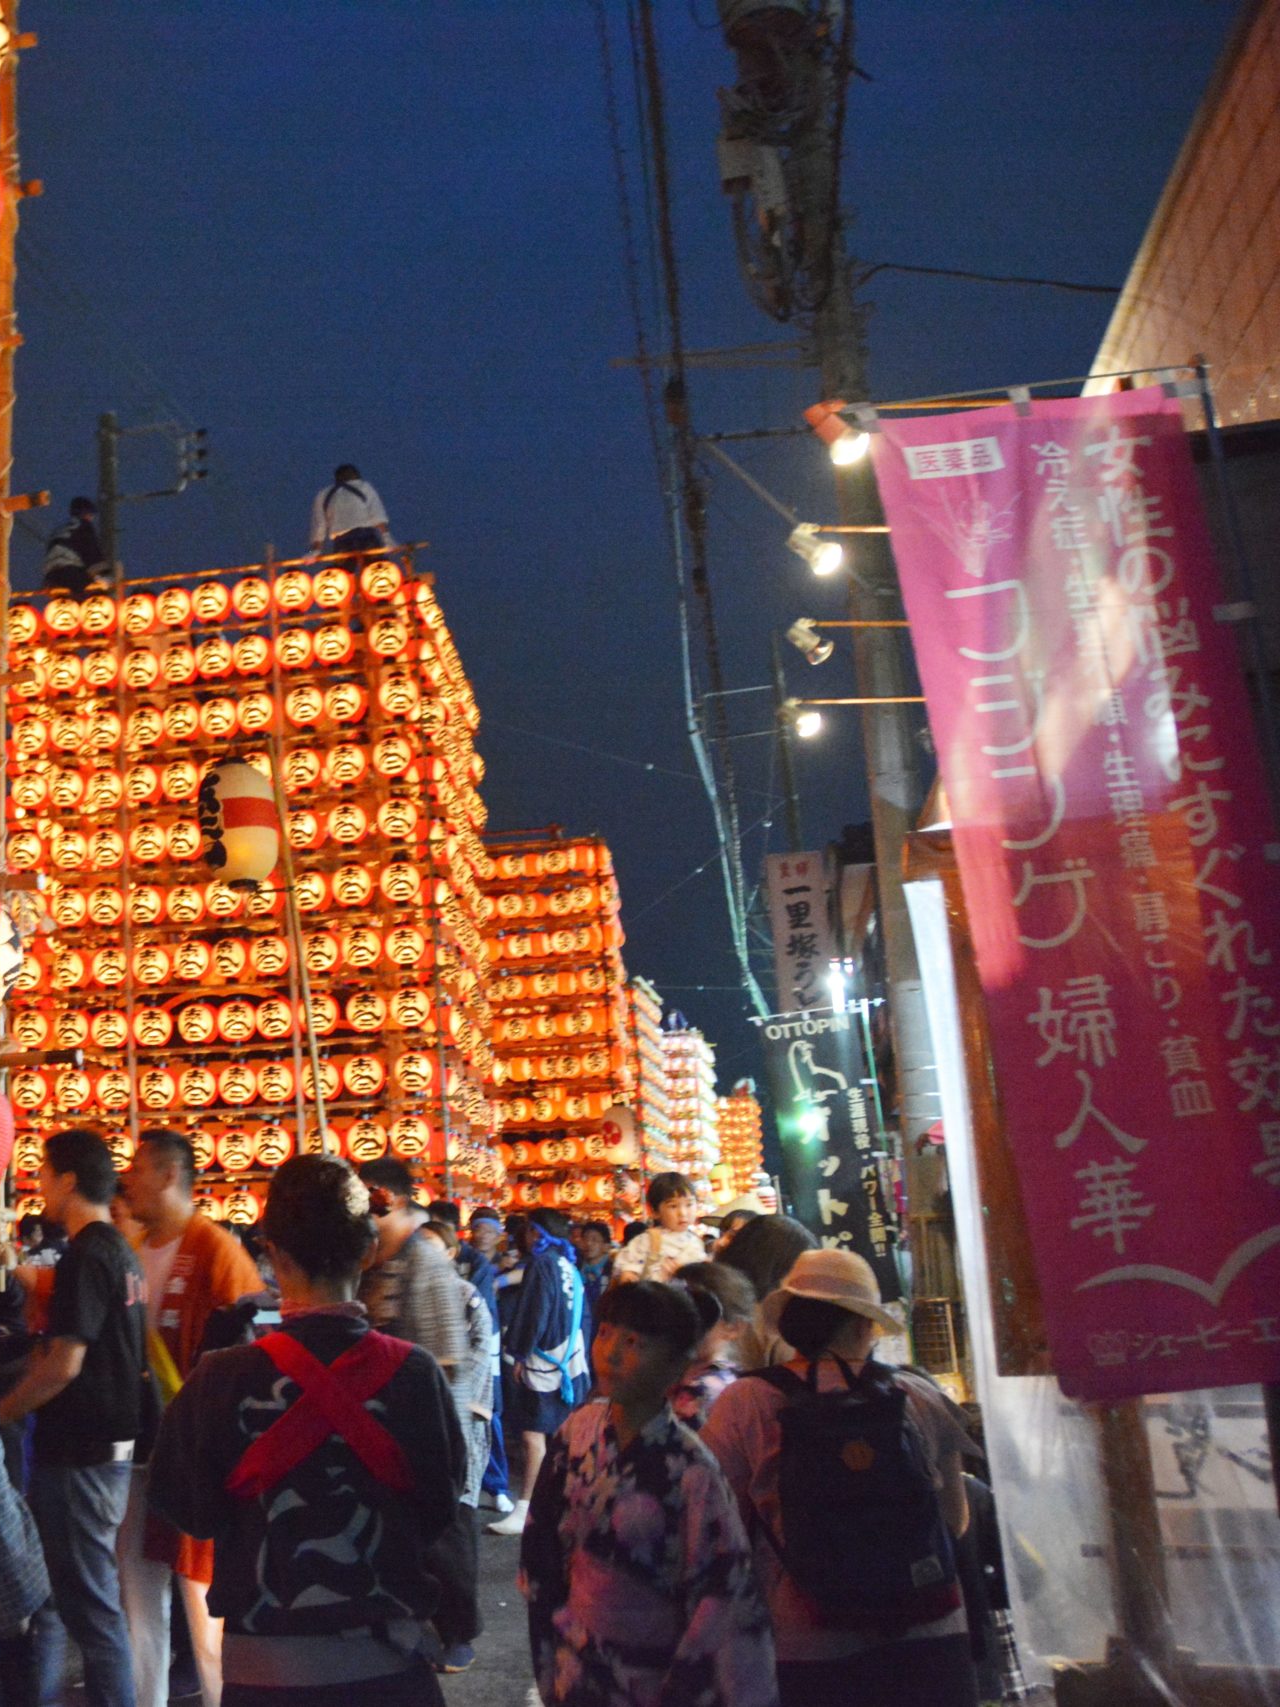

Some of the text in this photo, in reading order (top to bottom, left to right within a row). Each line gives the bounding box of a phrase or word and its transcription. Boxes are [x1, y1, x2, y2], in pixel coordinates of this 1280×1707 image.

[915, 441, 999, 475] 医薬品
[765, 1015, 850, 1042] OTTOPIN
